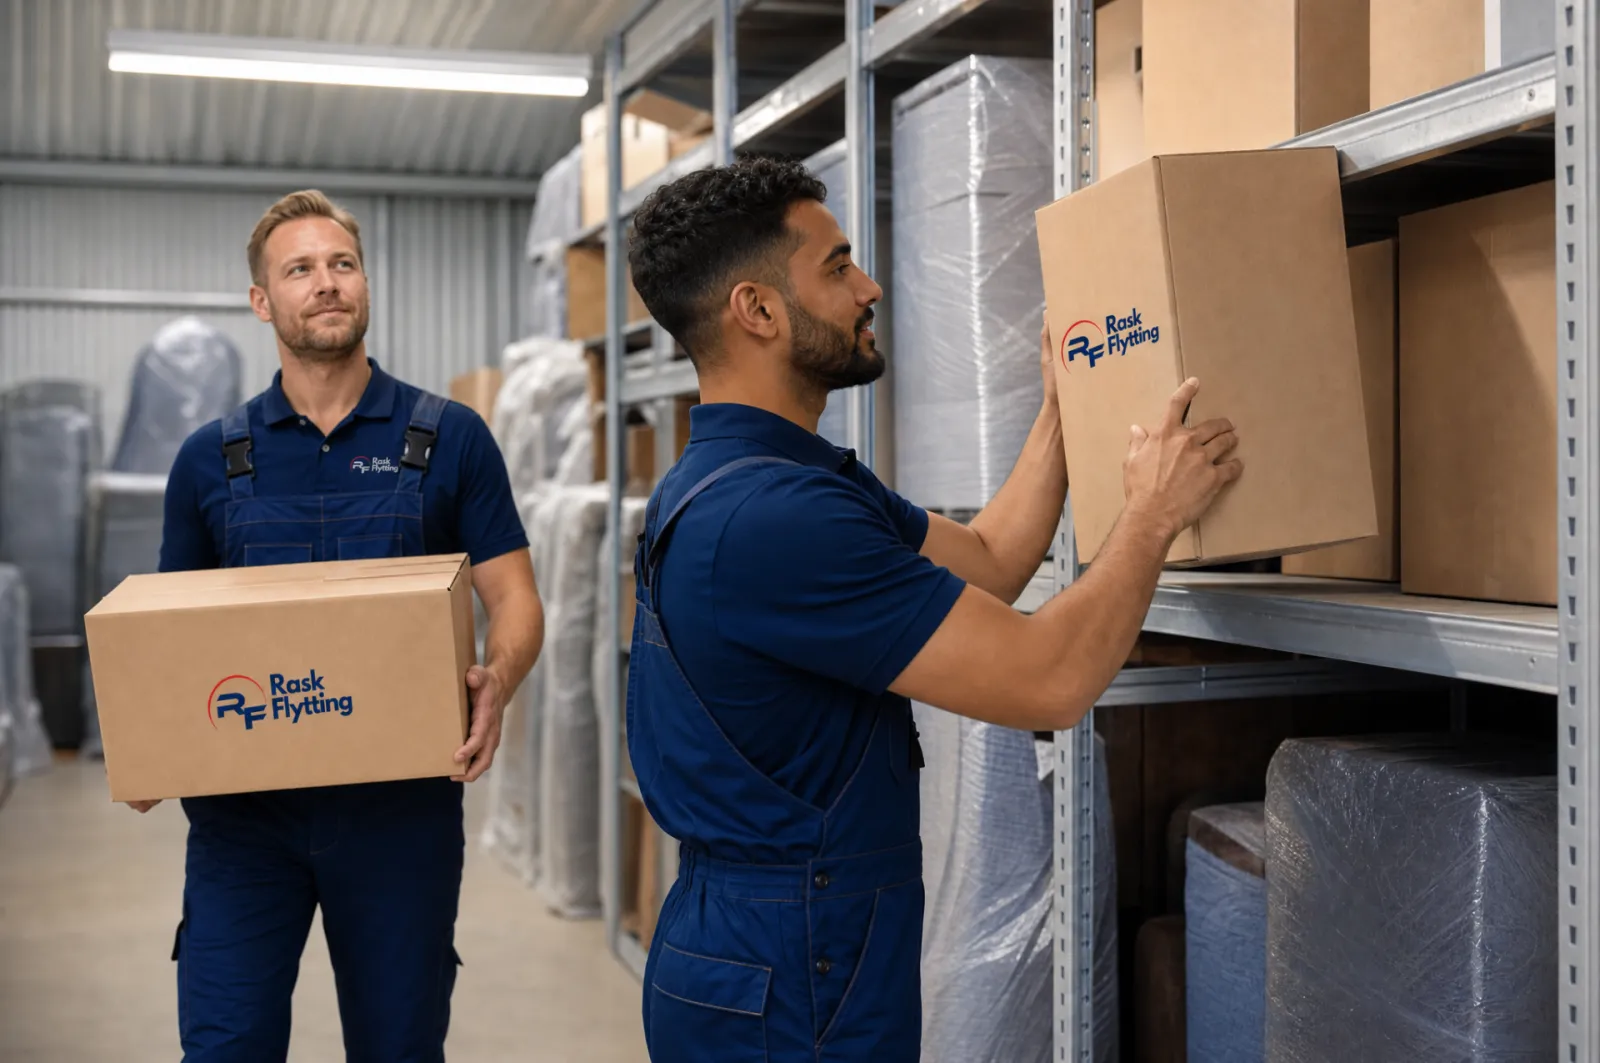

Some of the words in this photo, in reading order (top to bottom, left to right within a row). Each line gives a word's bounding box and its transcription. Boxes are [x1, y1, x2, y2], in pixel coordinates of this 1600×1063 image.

[1105, 307, 1142, 335] Rask
[1107, 326, 1160, 356] Flytting
[371, 464, 399, 473] Flytting
[372, 456, 391, 465] Rask
[269, 668, 326, 696] Rask
[271, 691, 353, 724] Flytting
